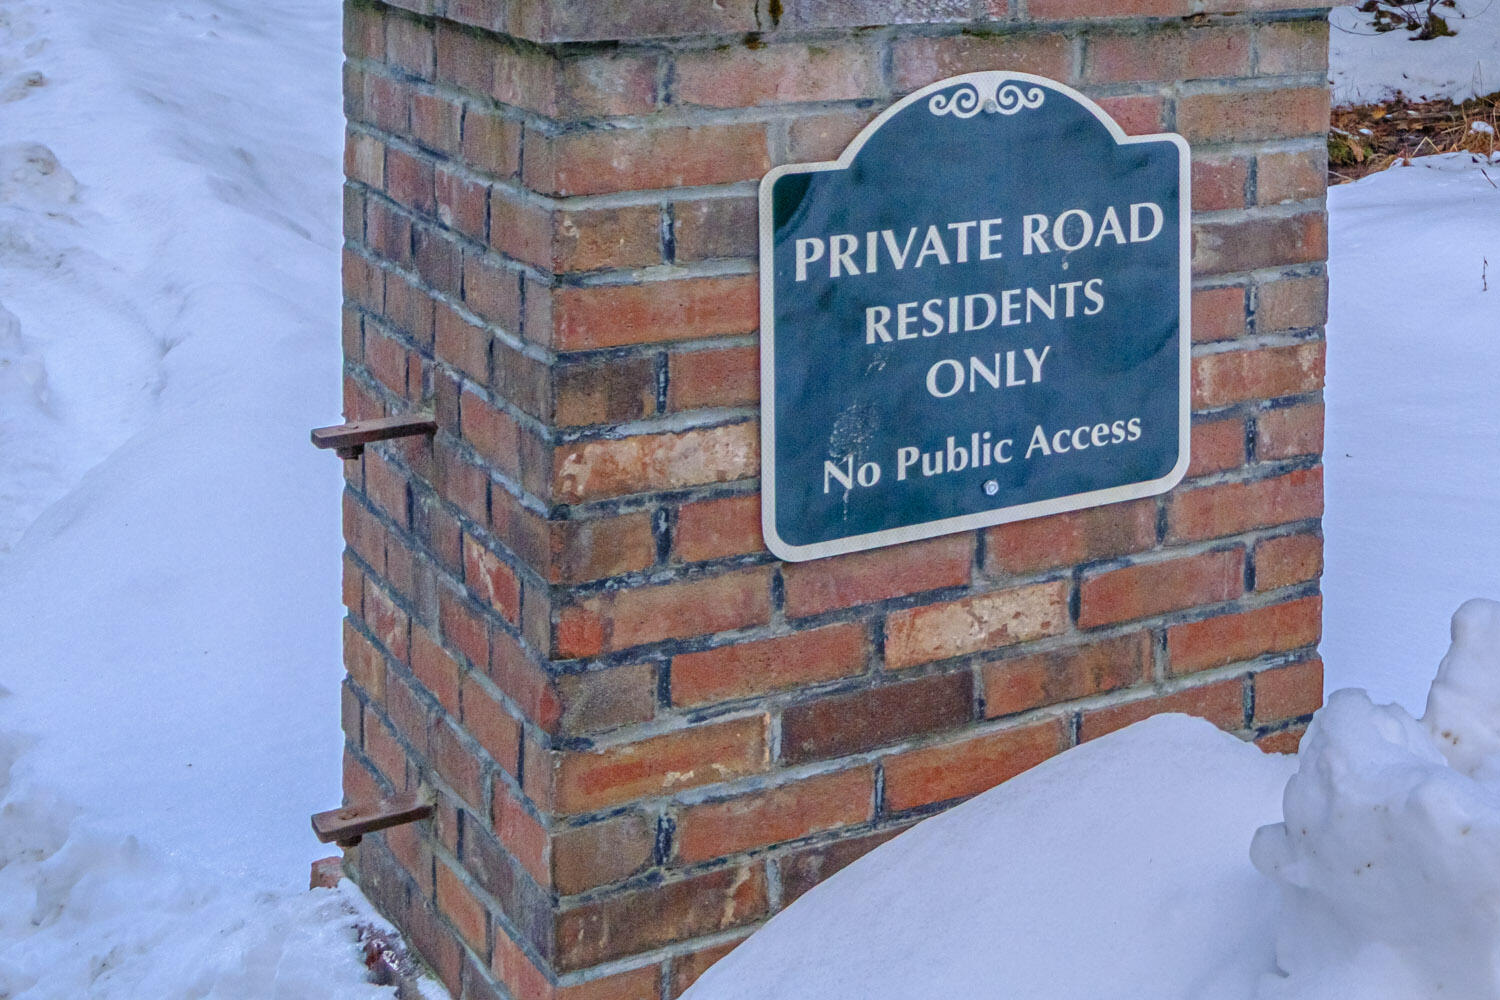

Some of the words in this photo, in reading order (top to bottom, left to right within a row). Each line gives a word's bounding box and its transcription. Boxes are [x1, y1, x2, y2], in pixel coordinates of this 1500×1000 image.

[795, 217, 1002, 282] PRIVATE
[1022, 202, 1164, 256] ROAD
[865, 278, 1104, 344] RESIDENTS
[926, 346, 1051, 398] ONLY
[823, 459, 880, 494] No
[897, 432, 1013, 480] Public
[1025, 416, 1142, 460] Access
